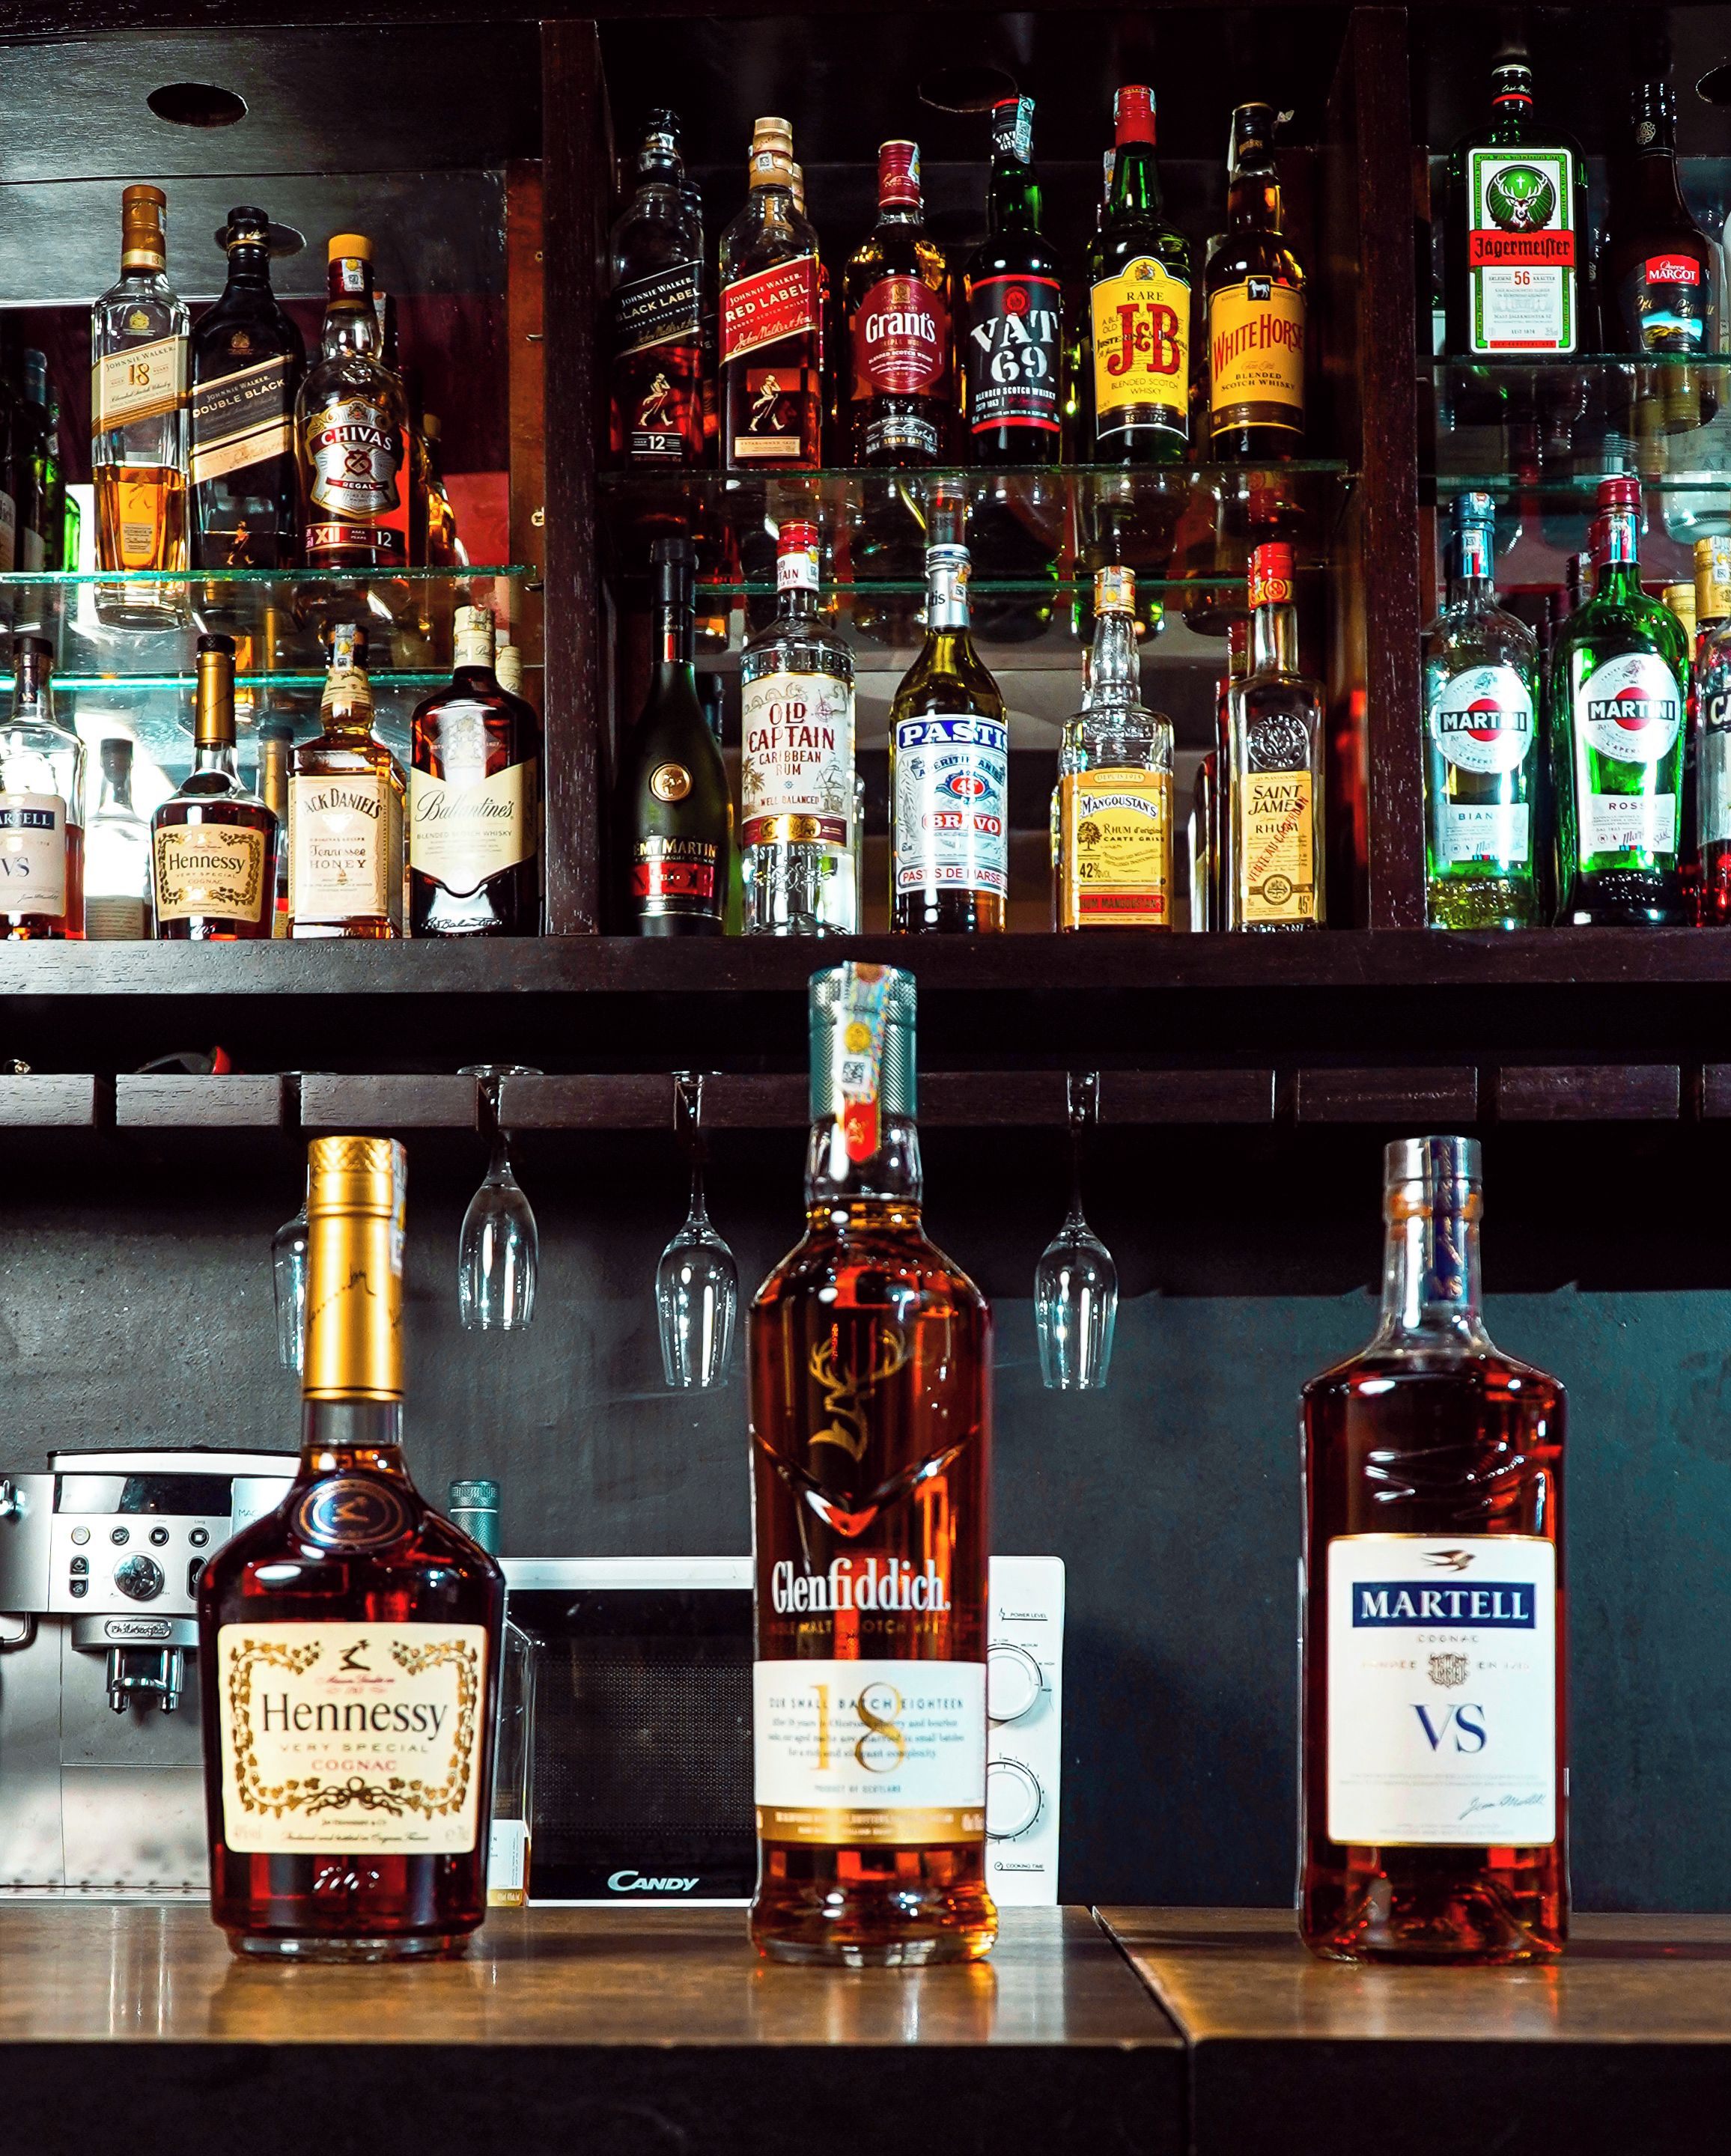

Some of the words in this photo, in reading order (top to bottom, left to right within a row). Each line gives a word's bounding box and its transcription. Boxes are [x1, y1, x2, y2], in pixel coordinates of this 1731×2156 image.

[1515, 271, 1530, 284] 56
[1649, 270, 1696, 280] MARGOT
[621, 289, 657, 308] JOHNNIE
[657, 277, 693, 293] WALKER
[729, 287, 764, 306] JOHNNIE
[767, 273, 801, 289] WALKER
[1127, 291, 1164, 302] RARE
[616, 301, 657, 322] BLACK
[660, 287, 702, 307] LABEL
[725, 302, 755, 323] RED
[759, 284, 809, 308] LABEL
[866, 312, 936, 343] Grant's
[970, 310, 1058, 353] VAT
[1107, 303, 1181, 376] J&B
[106, 354, 141, 371] JOHNNIE
[140, 346, 174, 361] WALKER
[1213, 321, 1257, 383] WHITE
[128, 363, 150, 386] 18
[1003, 386, 1030, 395] SCOTCH
[1221, 380, 1256, 391] SCOTCH
[1259, 379, 1295, 390] WHISKY
[193, 394, 241, 418] DOUBLE
[245, 378, 285, 400] BLACK
[321, 427, 392, 451] CHIVAS
[648, 436, 665, 449] 12
[342, 481, 374, 490] REGAL
[315, 527, 341, 544] XII
[377, 532, 392, 547] 12
[769, 702, 807, 725] OLD
[1590, 701, 1674, 720] MARTINI
[1442, 712, 1526, 731] MARTINI
[748, 726, 835, 753] CAPTAIN
[759, 751, 821, 765] CARIBBEAN
[776, 764, 801, 776] RUM
[760, 797, 779, 806] WELL
[782, 795, 820, 805] BALANCED
[1253, 785, 1303, 800] SAINT
[330, 788, 383, 819] DANIEL'S
[417, 832, 449, 840] BLENDED
[1104, 823, 1131, 835] RHUM
[663, 838, 717, 858] MARTIN
[1, 856, 30, 877] VS
[169, 853, 246, 874] Hennessy
[310, 859, 366, 868] HONEY
[946, 868, 963, 878] DE
[1360, 1591, 1529, 1618] MARTELL
[1417, 1635, 1480, 1643] COGNAC
[263, 1693, 448, 1741] Hennessy
[809, 1681, 905, 1773] 18
[1409, 1703, 1487, 1754] VS
[280, 1743, 331, 1753] VERY
[342, 1743, 430, 1753] SPECIAL
[311, 1759, 398, 1771] COGNAC
[607, 1870, 700, 1892] CANDY
